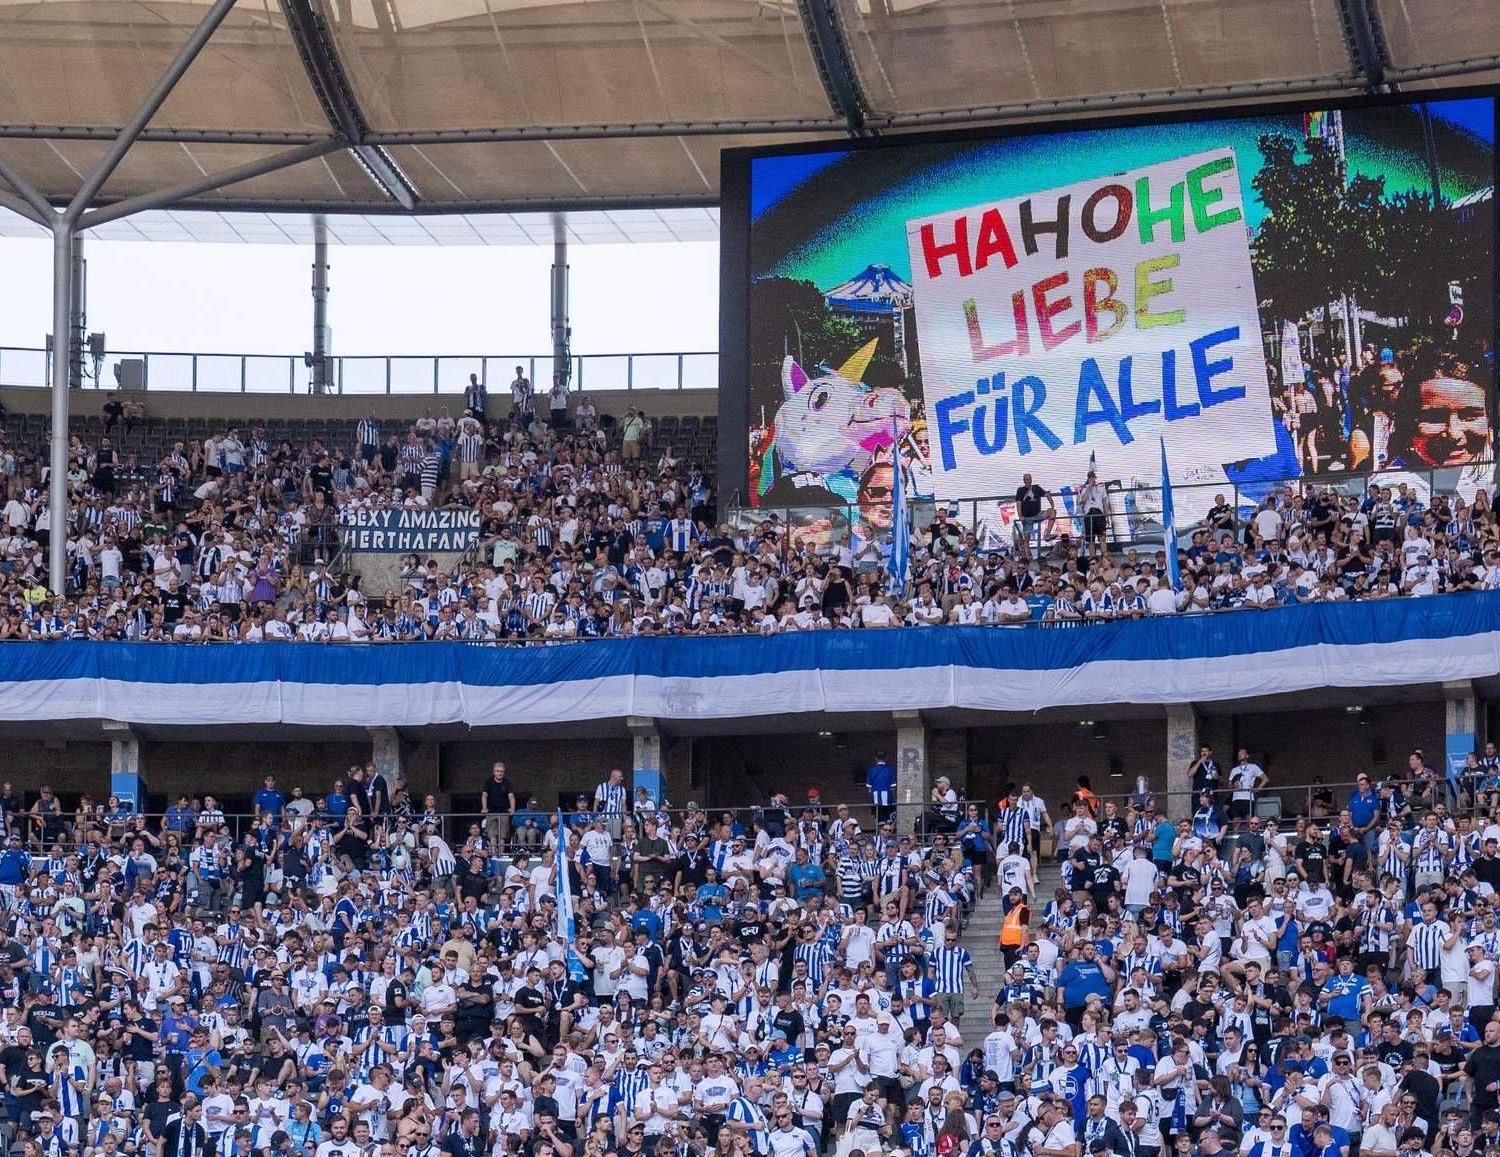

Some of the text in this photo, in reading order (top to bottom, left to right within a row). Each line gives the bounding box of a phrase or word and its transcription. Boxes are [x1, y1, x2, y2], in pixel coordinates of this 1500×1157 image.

[920, 156, 1242, 279] HAHOHE
[962, 253, 1186, 364] LIEBE
[935, 326, 1246, 471] FÜR ALLE
[345, 530, 480, 550] HERTHAFANS
[347, 509, 480, 529] SEXY AMAZING
